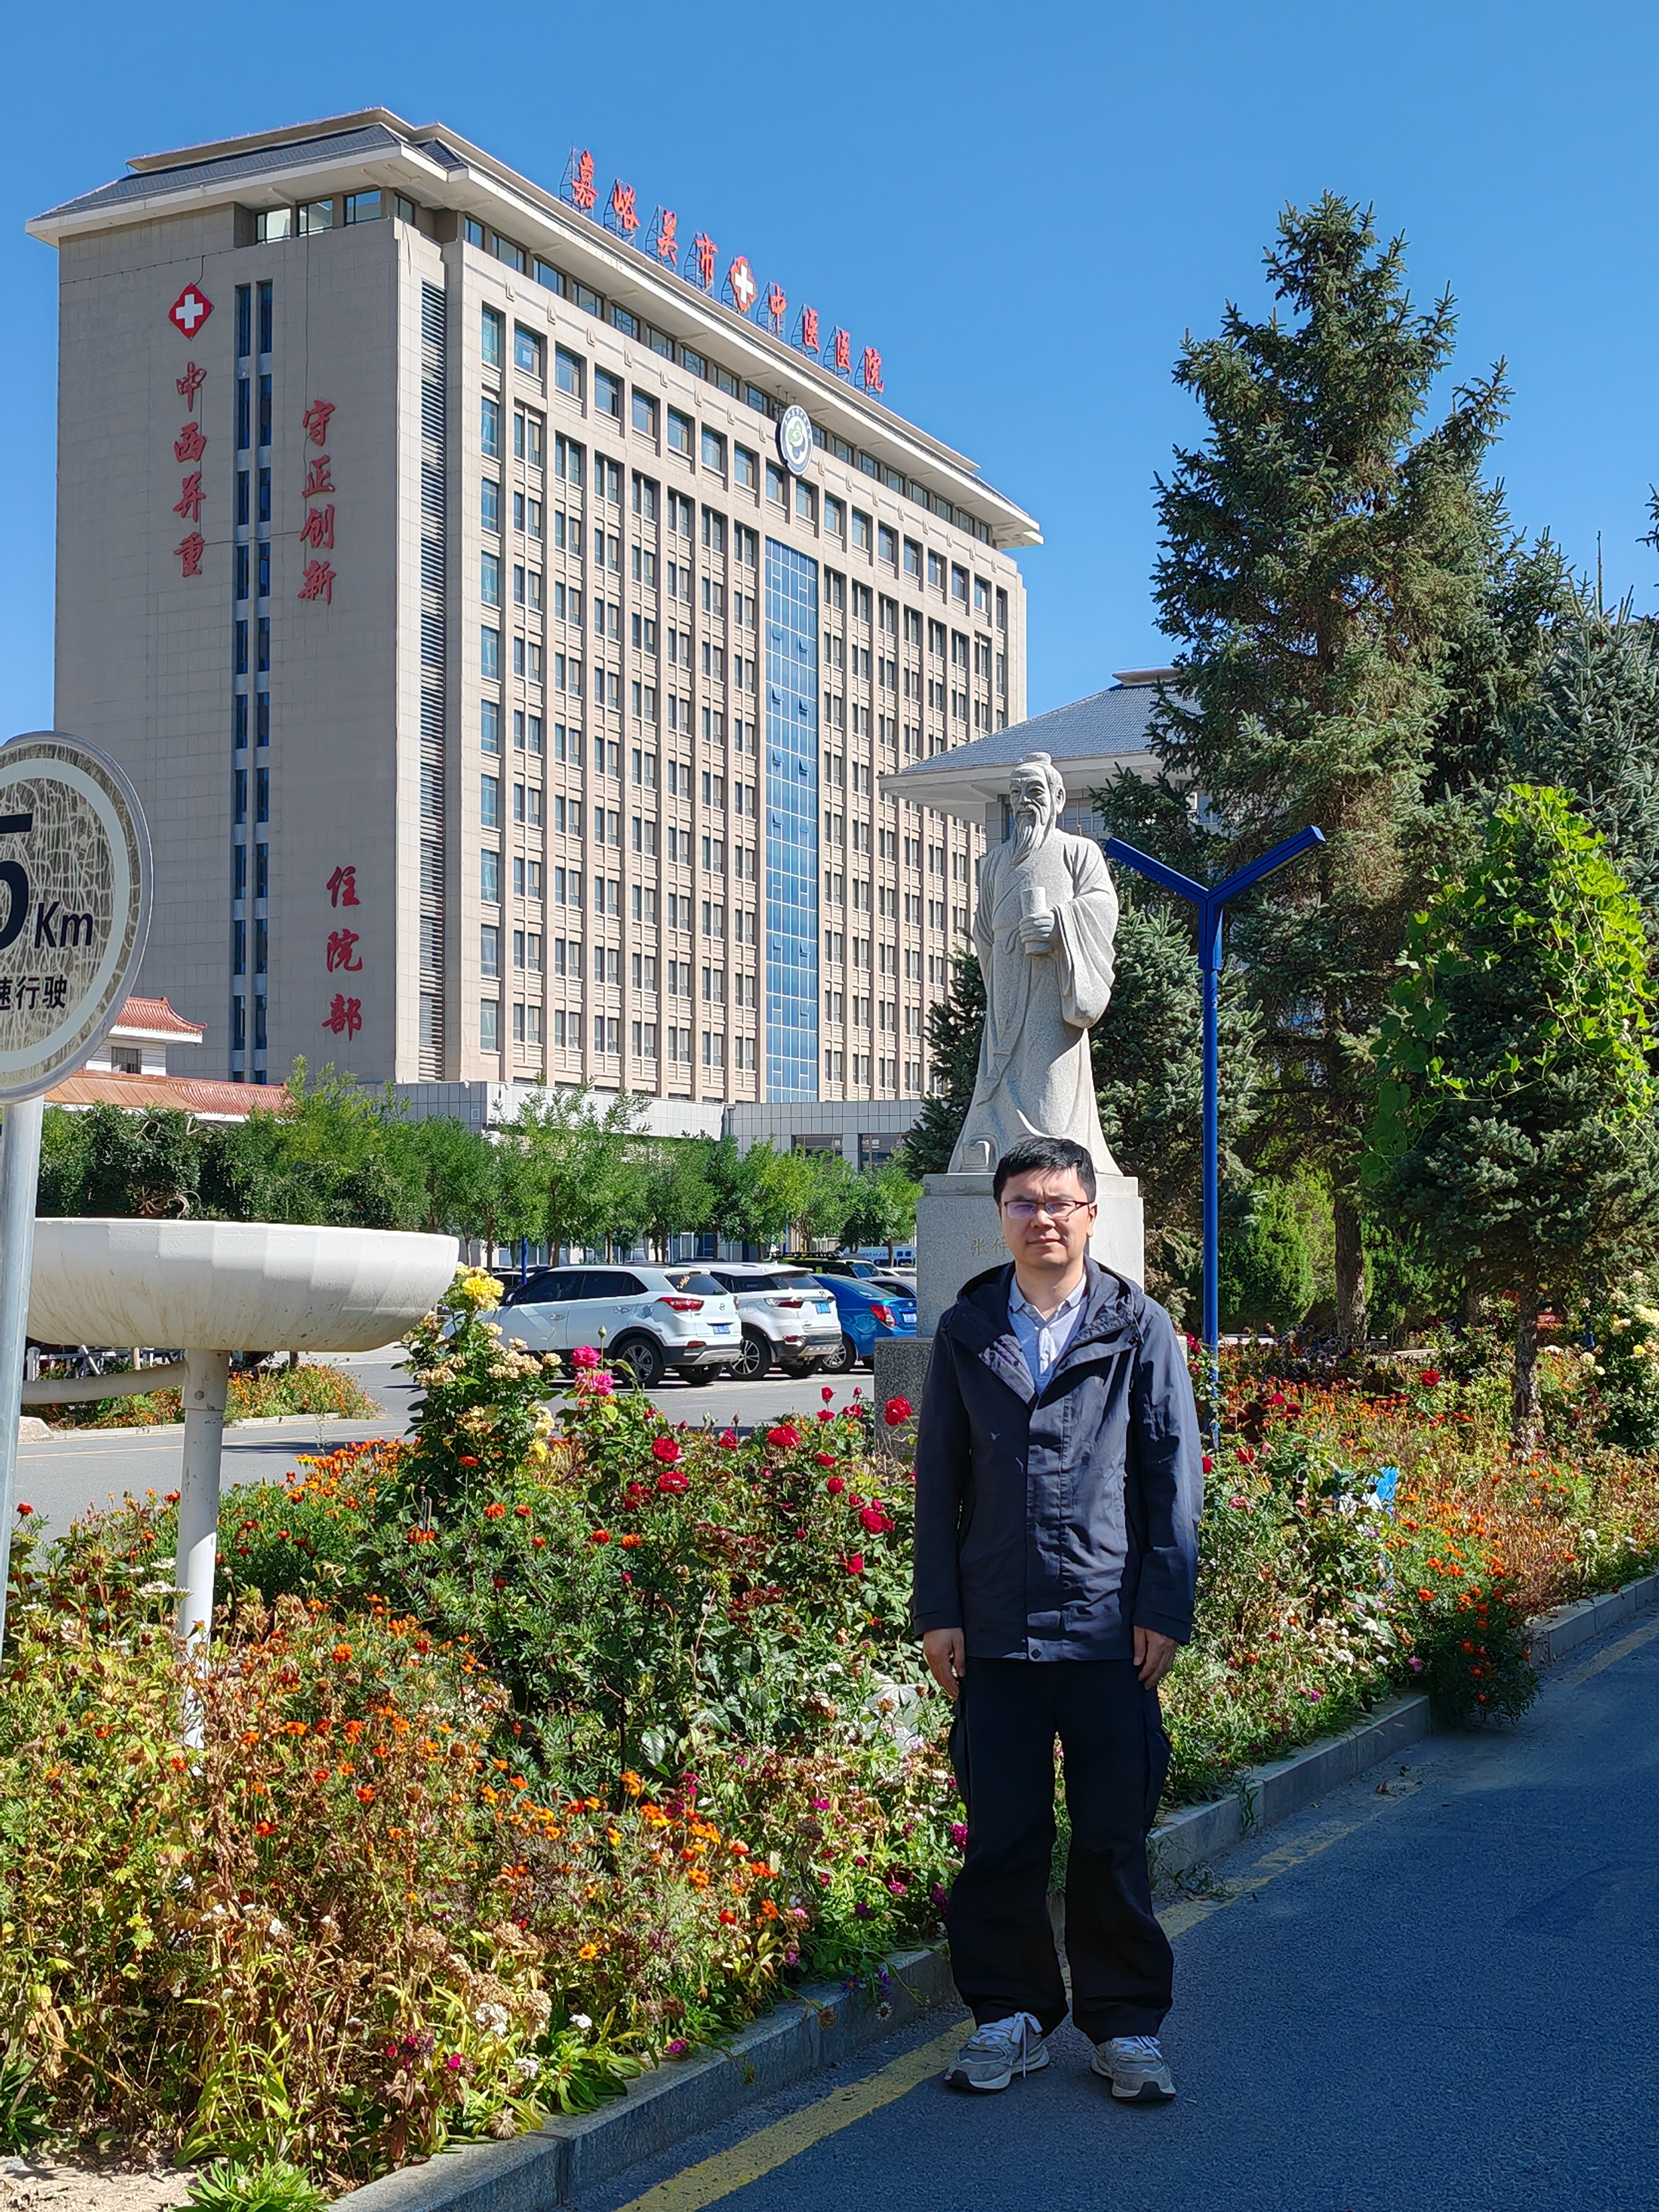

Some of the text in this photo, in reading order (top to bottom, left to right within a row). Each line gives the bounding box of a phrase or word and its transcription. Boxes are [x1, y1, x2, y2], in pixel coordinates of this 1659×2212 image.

[173, 361, 207, 577] 中西并重
[298, 400, 336, 605] 守正创新
[322, 865, 363, 1042] 住院部
